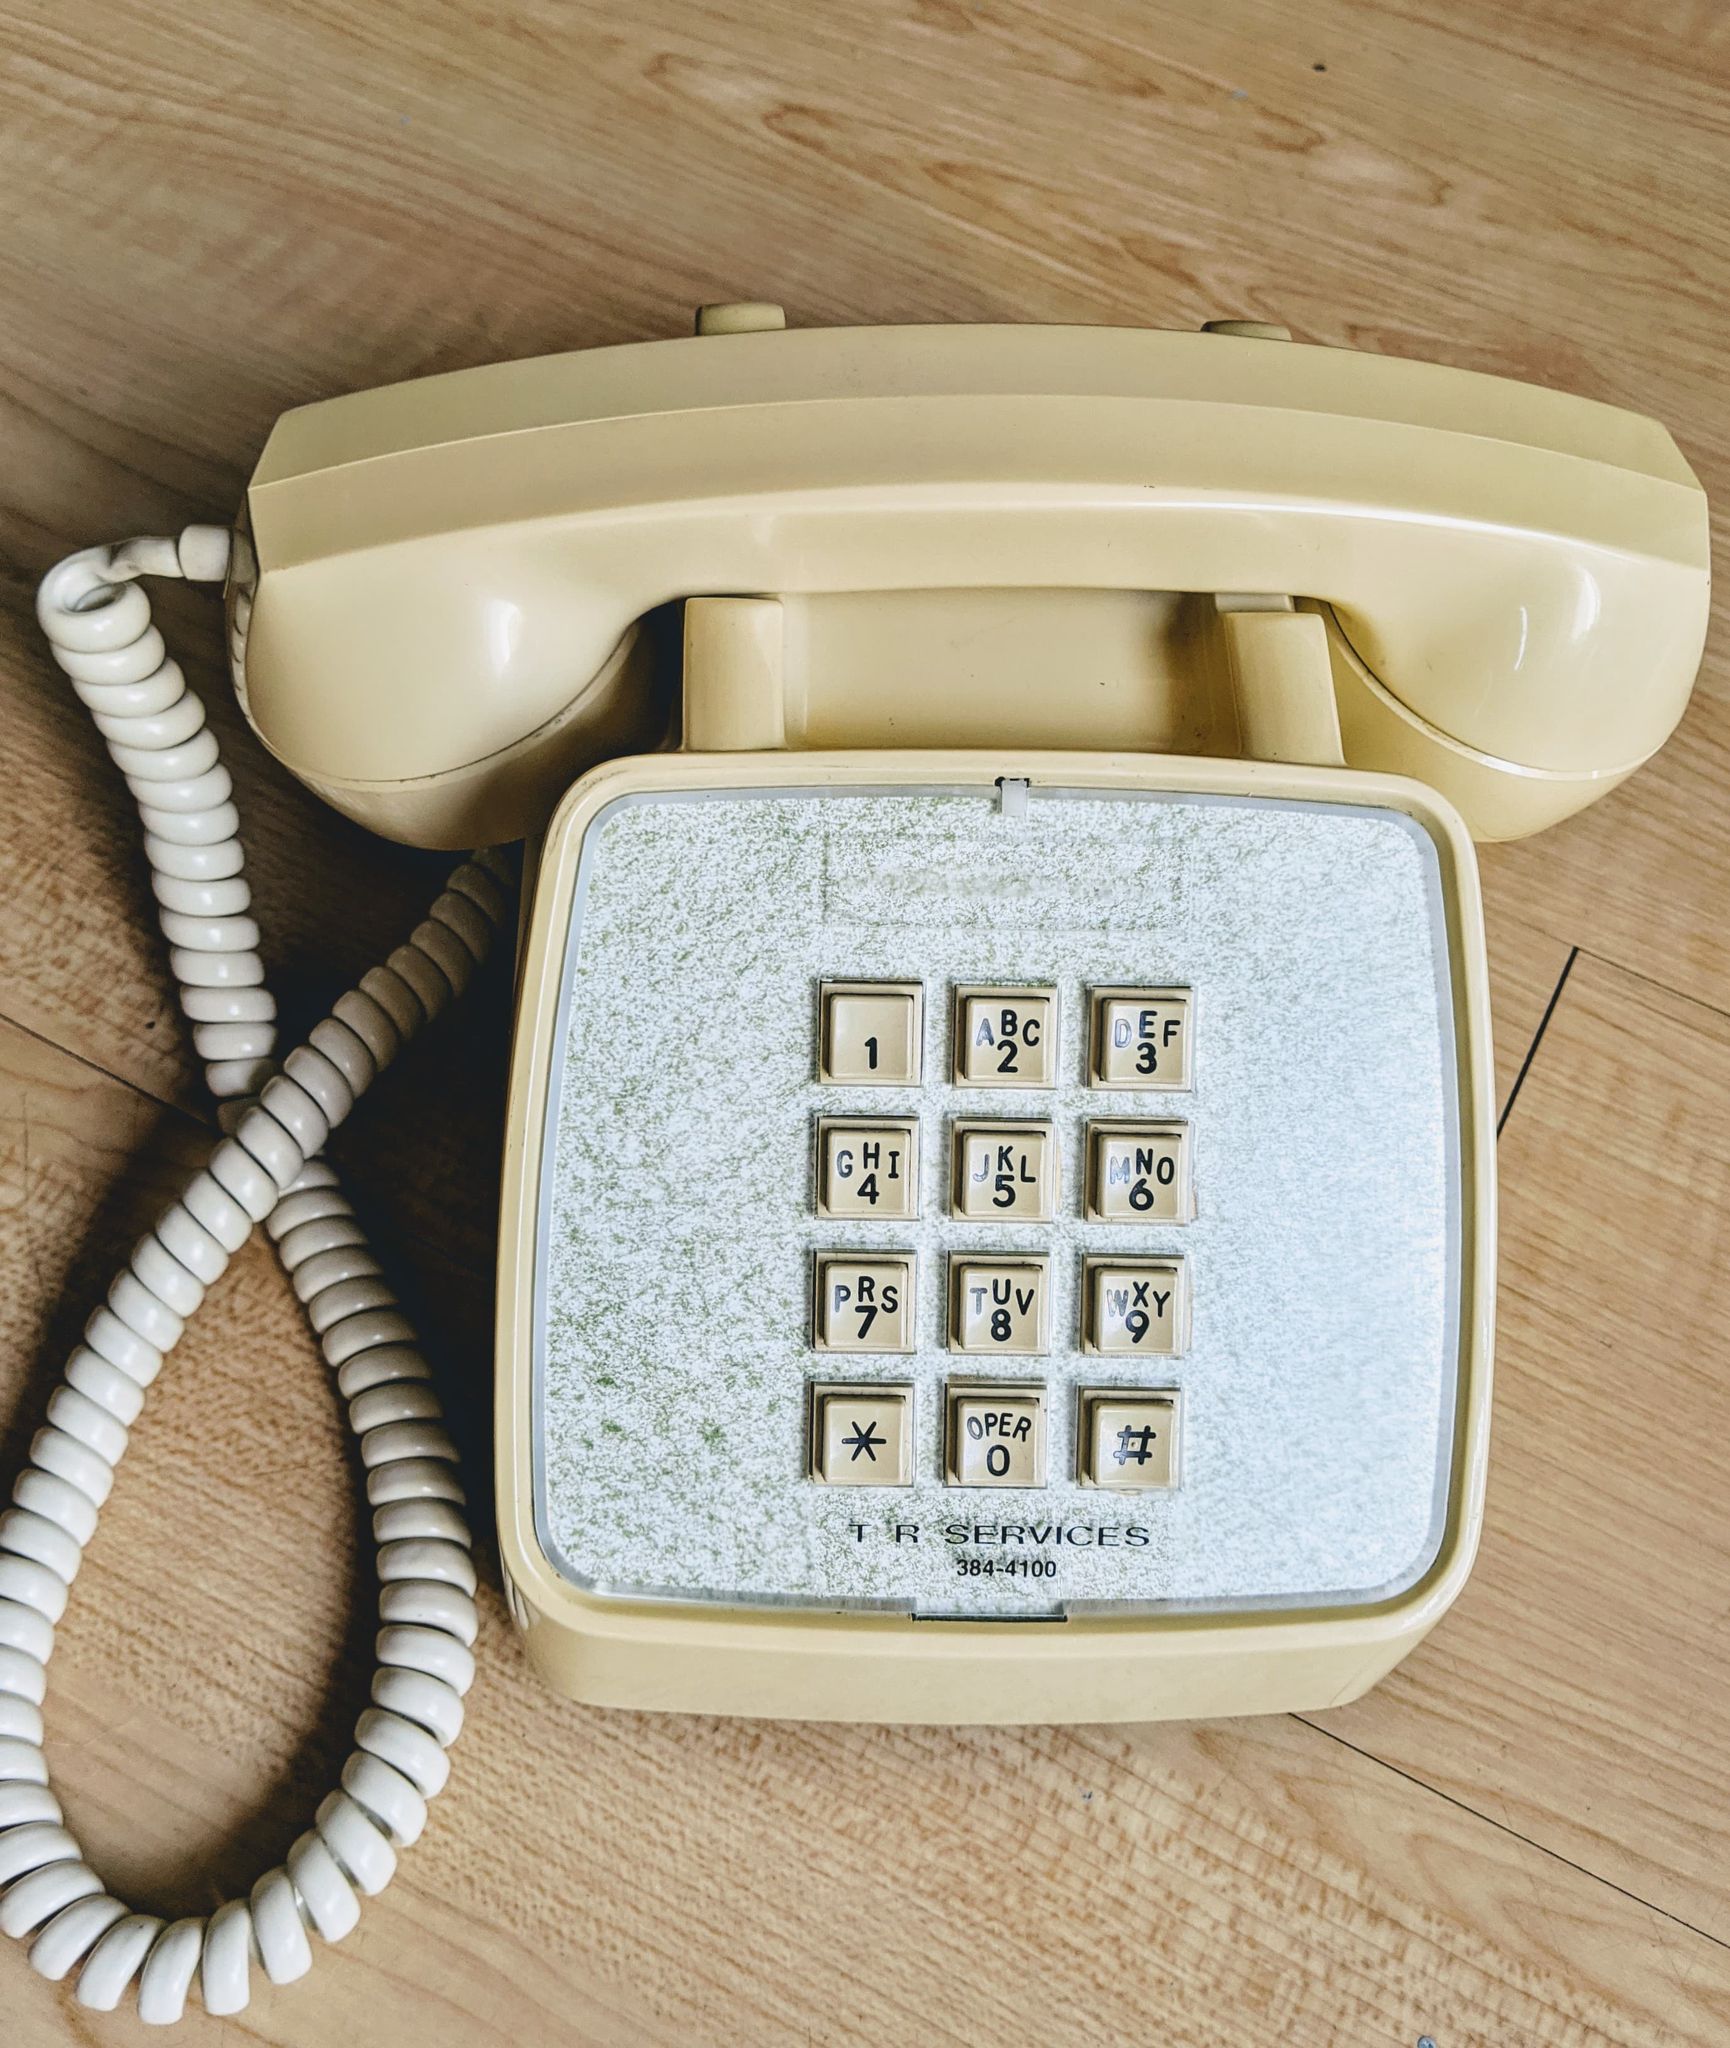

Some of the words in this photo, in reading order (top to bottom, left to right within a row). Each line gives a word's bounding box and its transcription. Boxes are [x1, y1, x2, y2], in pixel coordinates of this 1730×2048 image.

[975, 1009, 1040, 1046] ABC
[1114, 1010, 1181, 1048] DEF
[864, 1037, 878, 1070] 1
[997, 1040, 1018, 1073] 2
[1135, 1042, 1157, 1075] 3
[836, 1142, 900, 1179] GHI
[972, 1145, 1036, 1183] JKL
[1109, 1147, 1175, 1185] MNO
[857, 1174, 879, 1205] 4
[992, 1175, 1016, 1208] 5
[1129, 1178, 1154, 1211] 6
[834, 1275, 898, 1314] PRS
[969, 1278, 1035, 1315] TUV
[1106, 1281, 1170, 1318] WXY
[854, 1305, 878, 1339] 7
[990, 1309, 1012, 1342] 8
[1125, 1310, 1150, 1343] 9
[966, 1412, 1031, 1442] OPER
[987, 1444, 1010, 1477] 0
[1113, 1425, 1156, 1466] #
[848, 1523, 872, 1543] T
[895, 1523, 920, 1544] R
[944, 1524, 1150, 1547] SERVICES
[956, 1559, 1057, 1578] 384-4100
